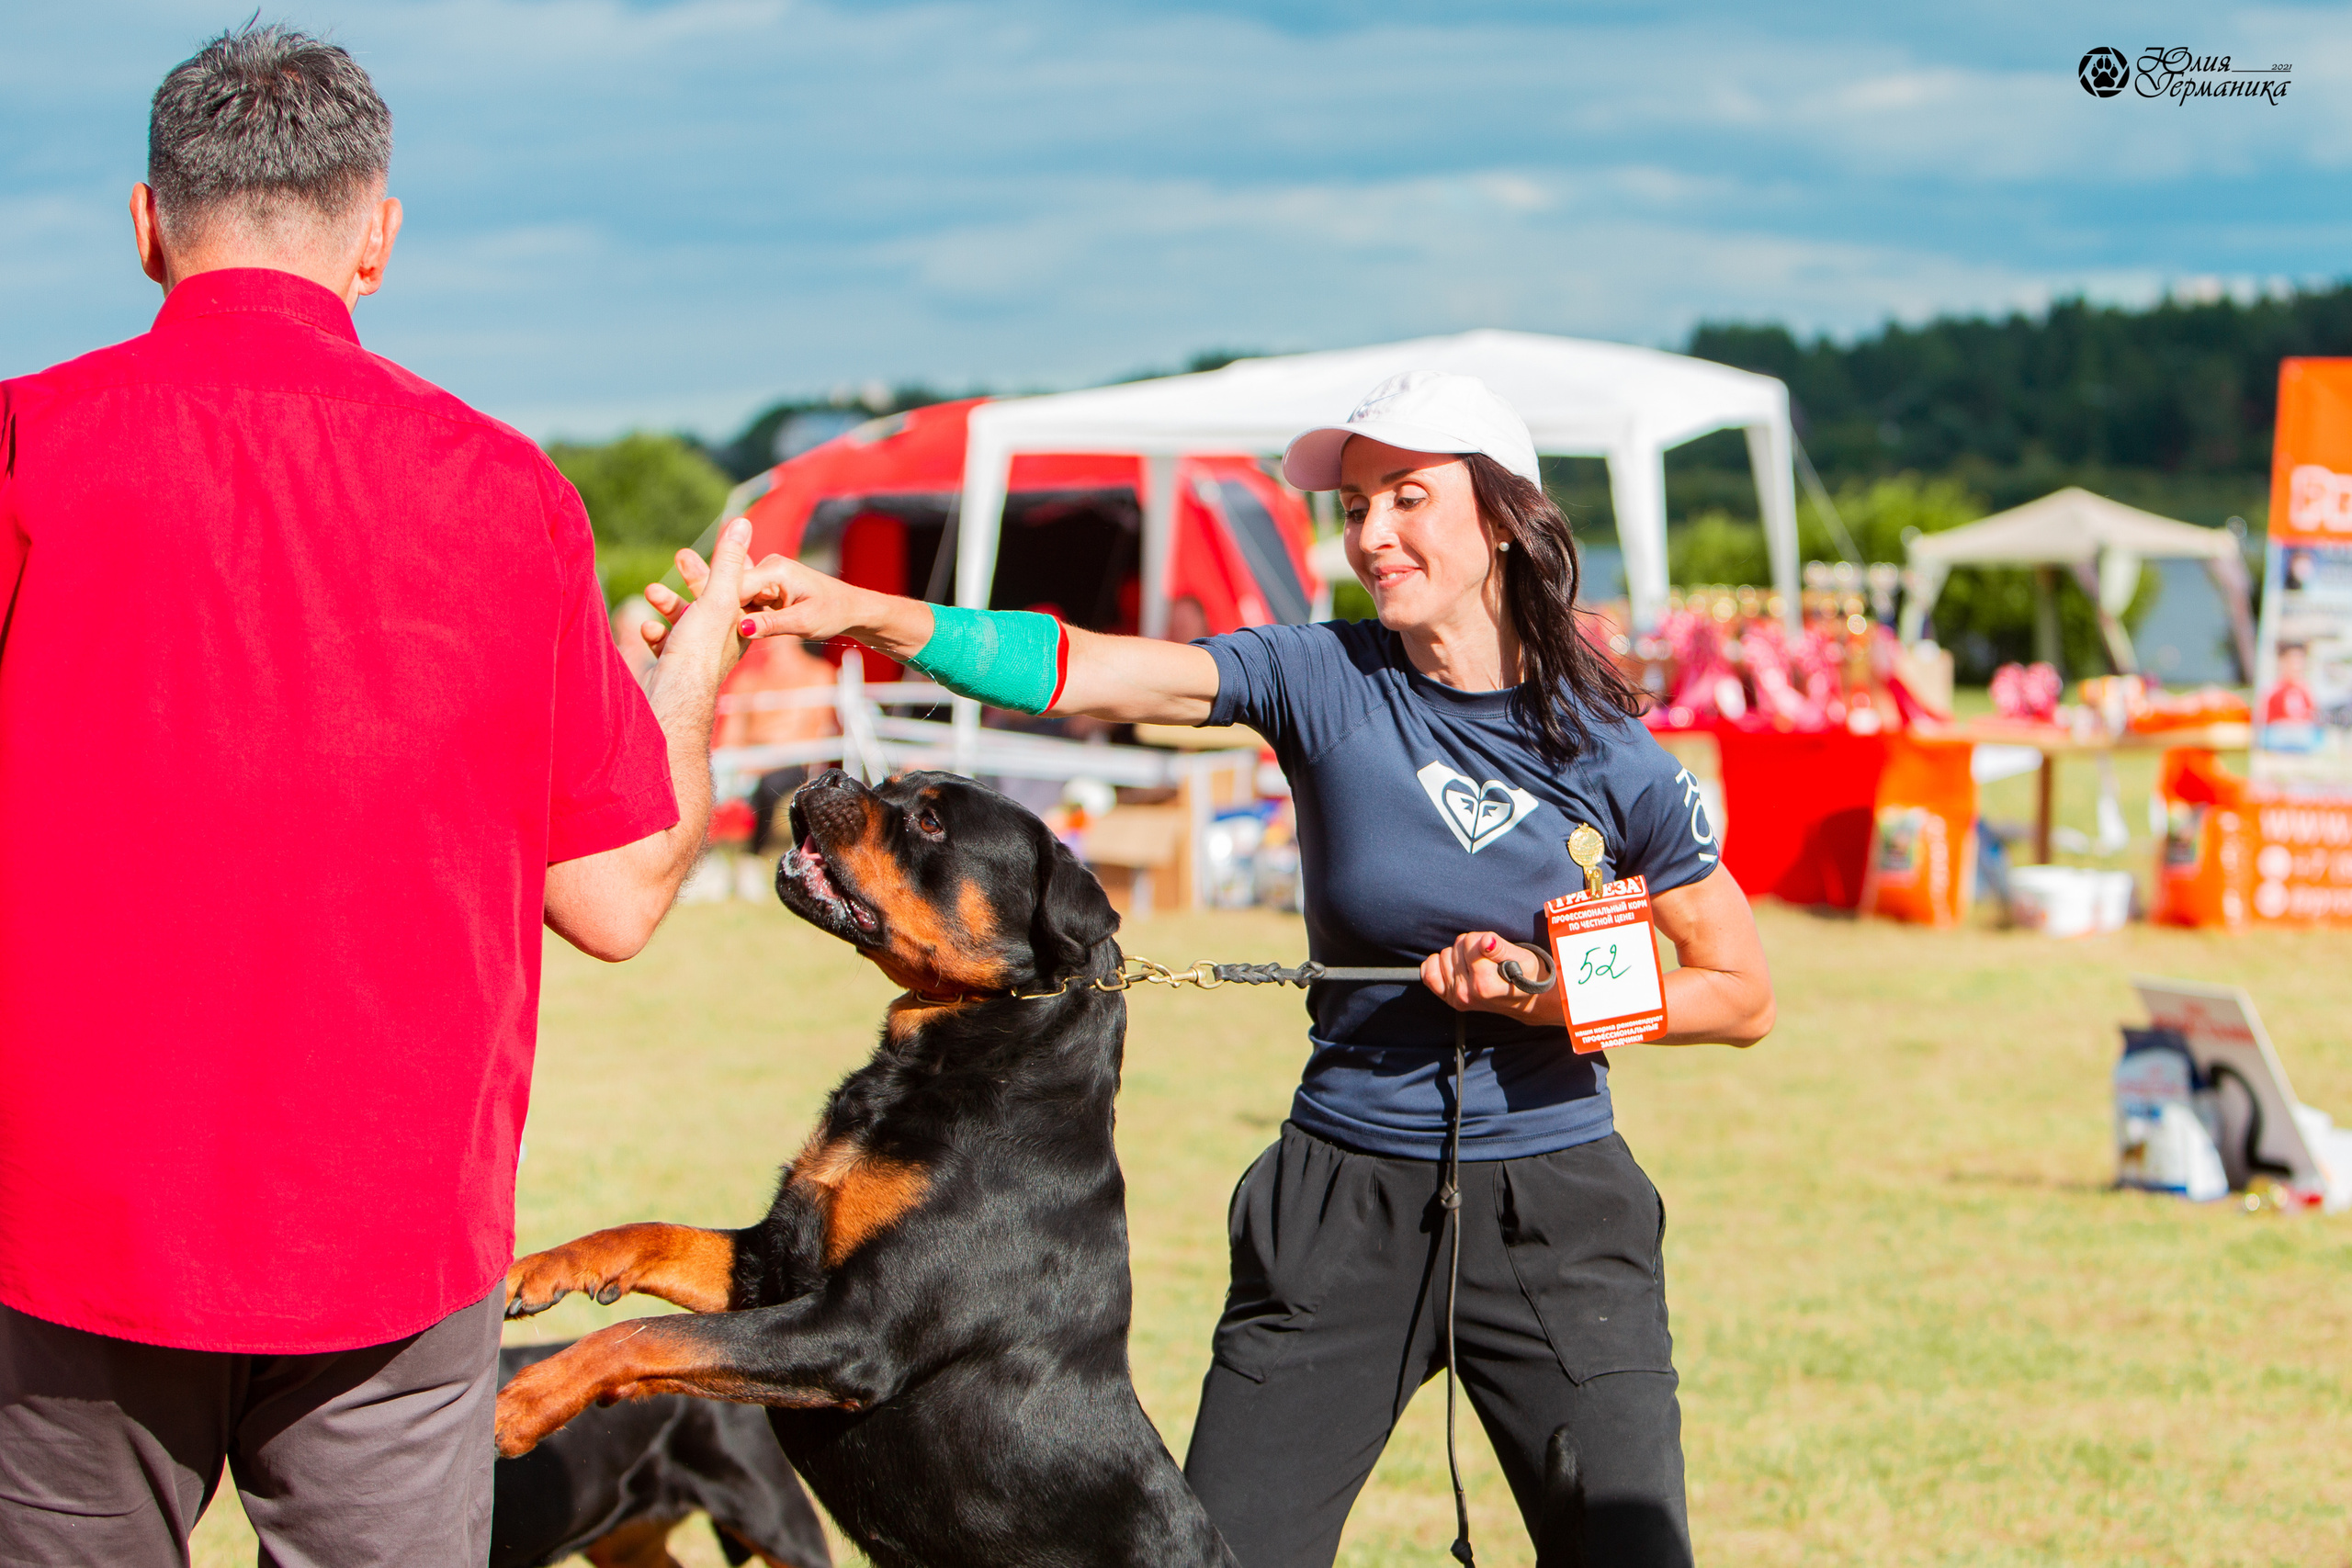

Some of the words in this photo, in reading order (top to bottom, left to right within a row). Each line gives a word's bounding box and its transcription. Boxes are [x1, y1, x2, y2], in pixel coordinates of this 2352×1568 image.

[1556, 878, 1642, 908] ТРАЕЗА
[1552, 902, 1627, 924] ПРОФЕССИОНАЛЬНЫЙ
[1628, 899, 1647, 910] КОРМ
[1568, 922, 1580, 931] ПО
[1581, 915, 1613, 929] ЧЕСТНОЙ
[1614, 912, 1634, 923] ЦЕНЕ!
[1578, 944, 1632, 985] 52
[1575, 1029, 1593, 1037] наши
[1594, 1024, 1616, 1034] корма
[1616, 1015, 1663, 1030] рекомендуют
[1582, 1023, 1658, 1043] ПРОФЕССИОНАЛЬНЫЕ
[1600, 1034, 1643, 1048] ЗАВОДЧИКИ
